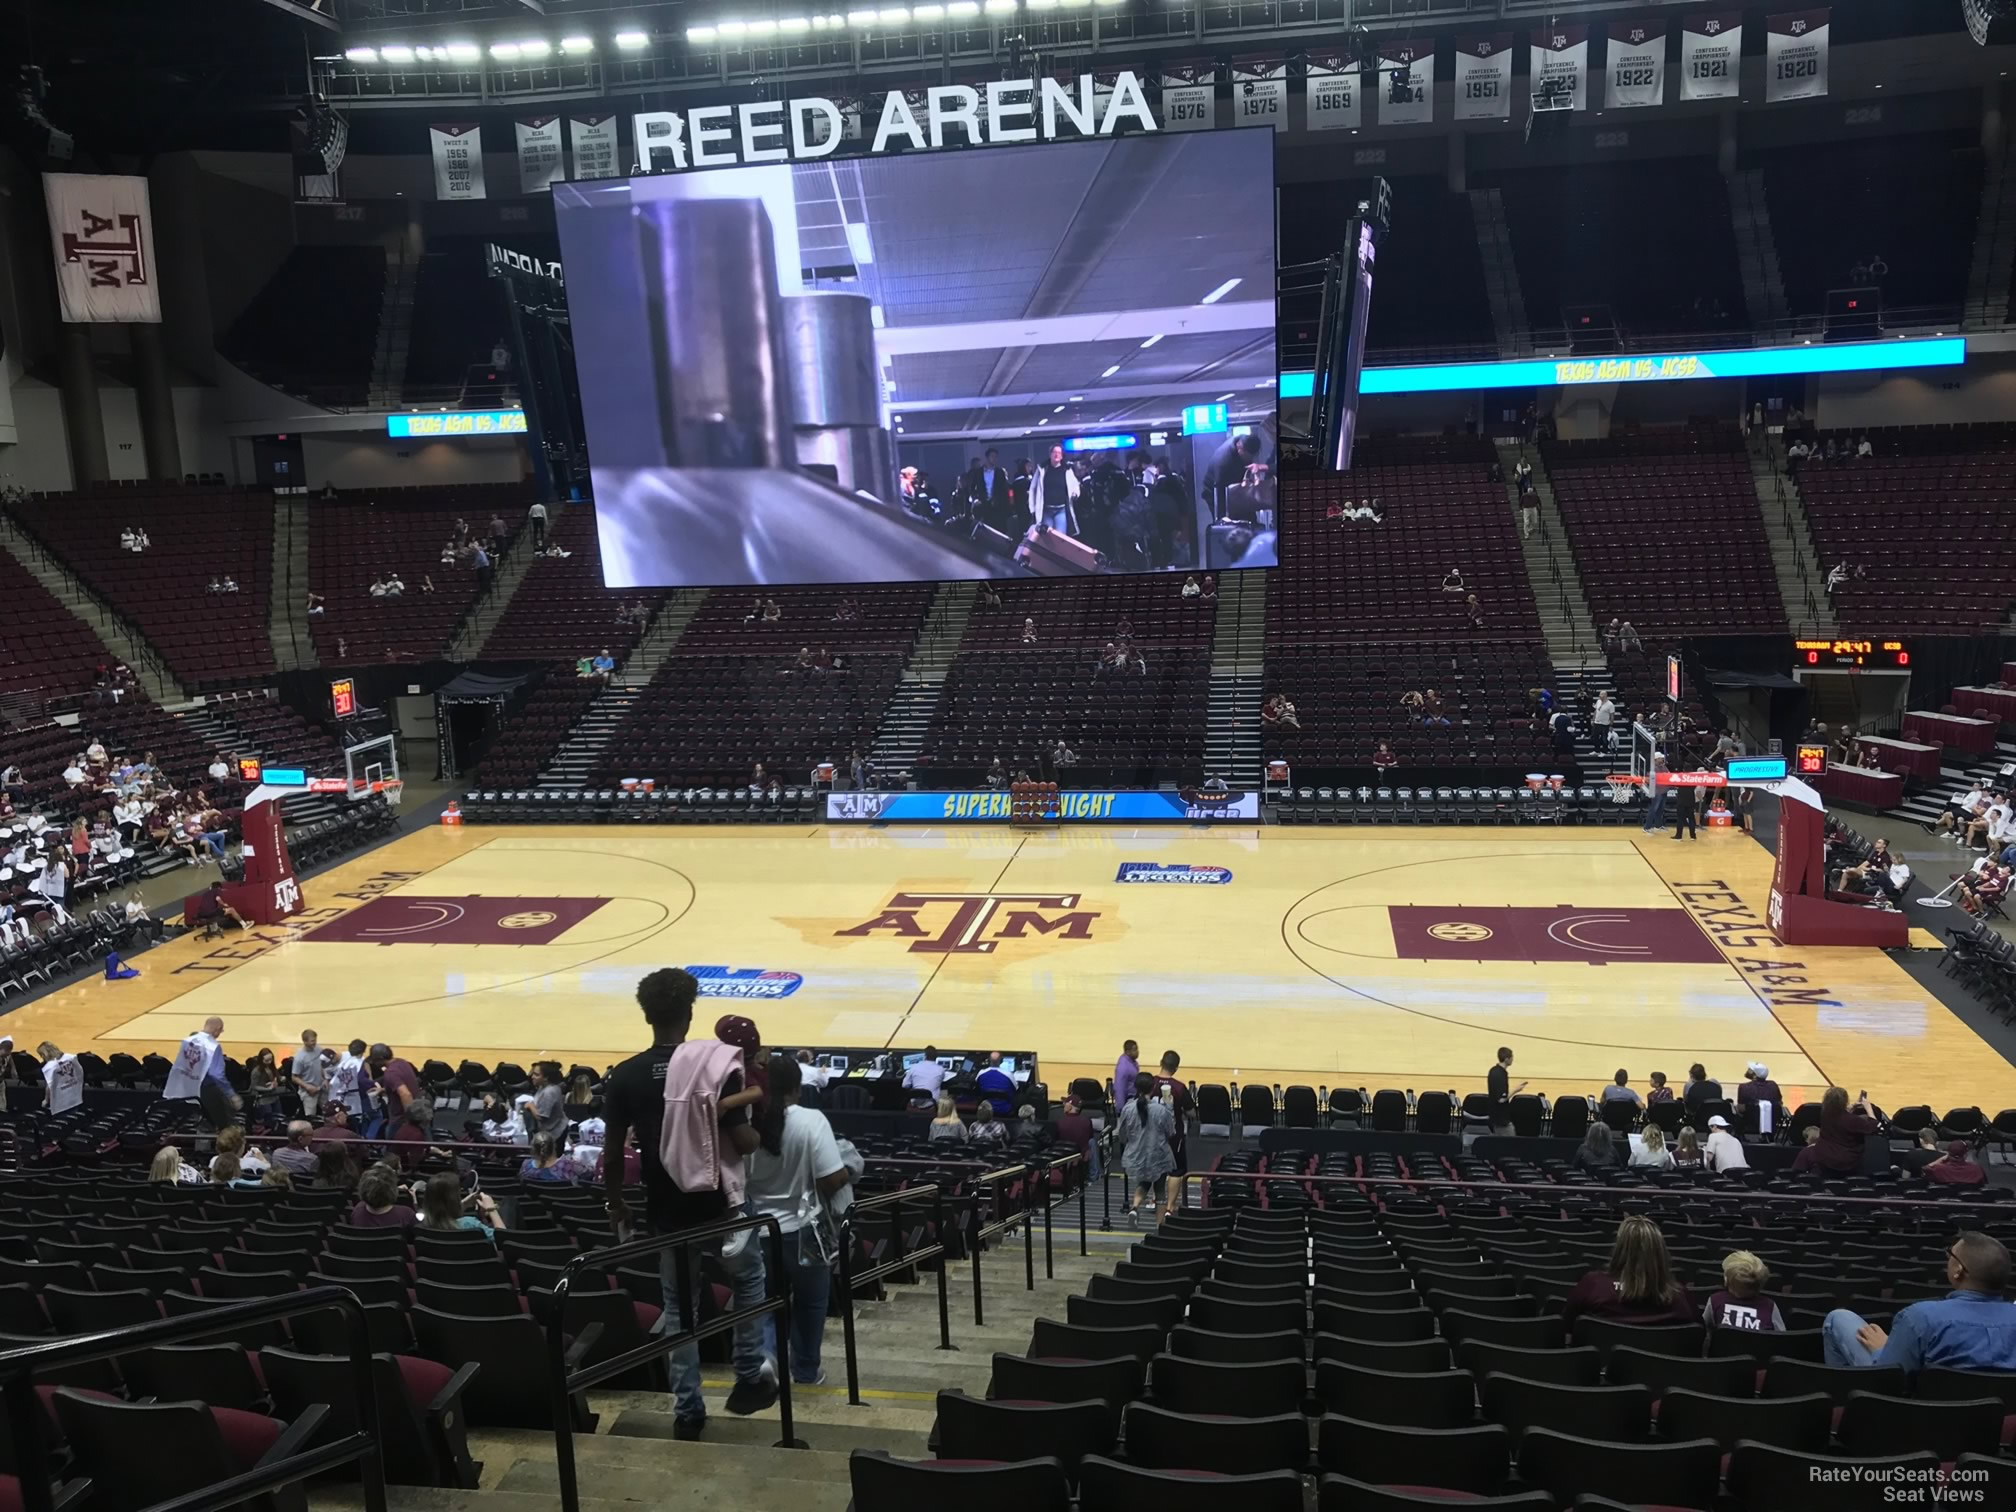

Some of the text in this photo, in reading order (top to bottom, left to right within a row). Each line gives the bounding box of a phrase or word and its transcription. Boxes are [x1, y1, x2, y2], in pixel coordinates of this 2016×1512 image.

[1615, 69, 1654, 86] 1922
[1693, 60, 1728, 79] 1921
[1777, 59, 1817, 80] 1920
[1466, 81, 1499, 98] 1951
[1243, 97, 1278, 115] 1975
[1315, 93, 1352, 110] 1969
[1171, 103, 1206, 120] 1976
[634, 71, 1158, 171] REED ARENA
[446, 148, 468, 159] 1969
[447, 160, 469, 170] 1980
[448, 171, 470, 180] 2007
[450, 181, 471, 191] 2016
[1555, 356, 1697, 382] TEXAS A&M VS. UCSB
[408, 416, 441, 433] TEXAS
[445, 415, 473, 432] A&M
[1833, 641, 1872, 653] 29:47
[1809, 651, 1818, 663] 0
[1900, 652, 1908, 664] 0
[336, 694, 351, 713] 30
[1734, 765, 1779, 773] PROGRESSIVE
[1804, 758, 1820, 770] 30
[244, 768, 258, 779] 30
[332, 871, 423, 901] A&M
[1673, 879, 1844, 1007] TEXAS A&M
